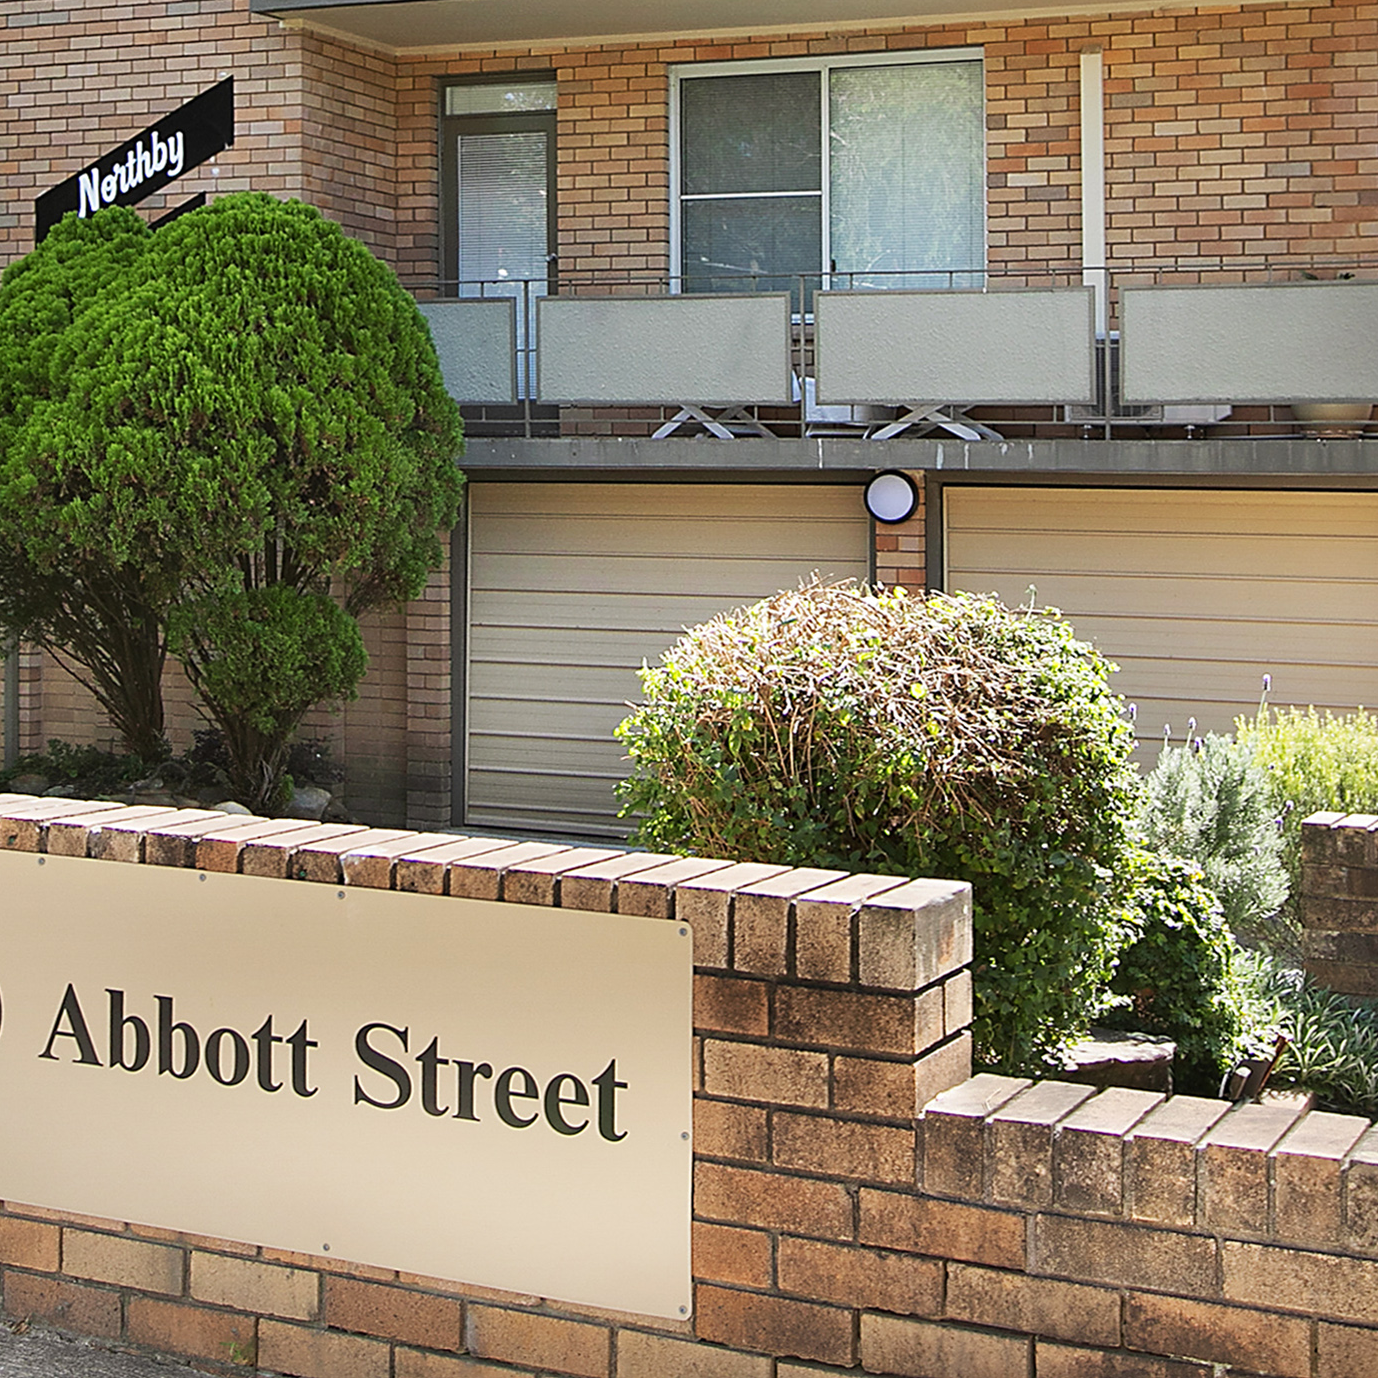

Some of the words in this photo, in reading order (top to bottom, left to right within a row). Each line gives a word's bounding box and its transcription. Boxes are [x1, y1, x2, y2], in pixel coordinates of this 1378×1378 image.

[78, 130, 184, 218] Northby
[36, 981, 320, 1099] Abbott
[353, 1021, 630, 1144] Street
